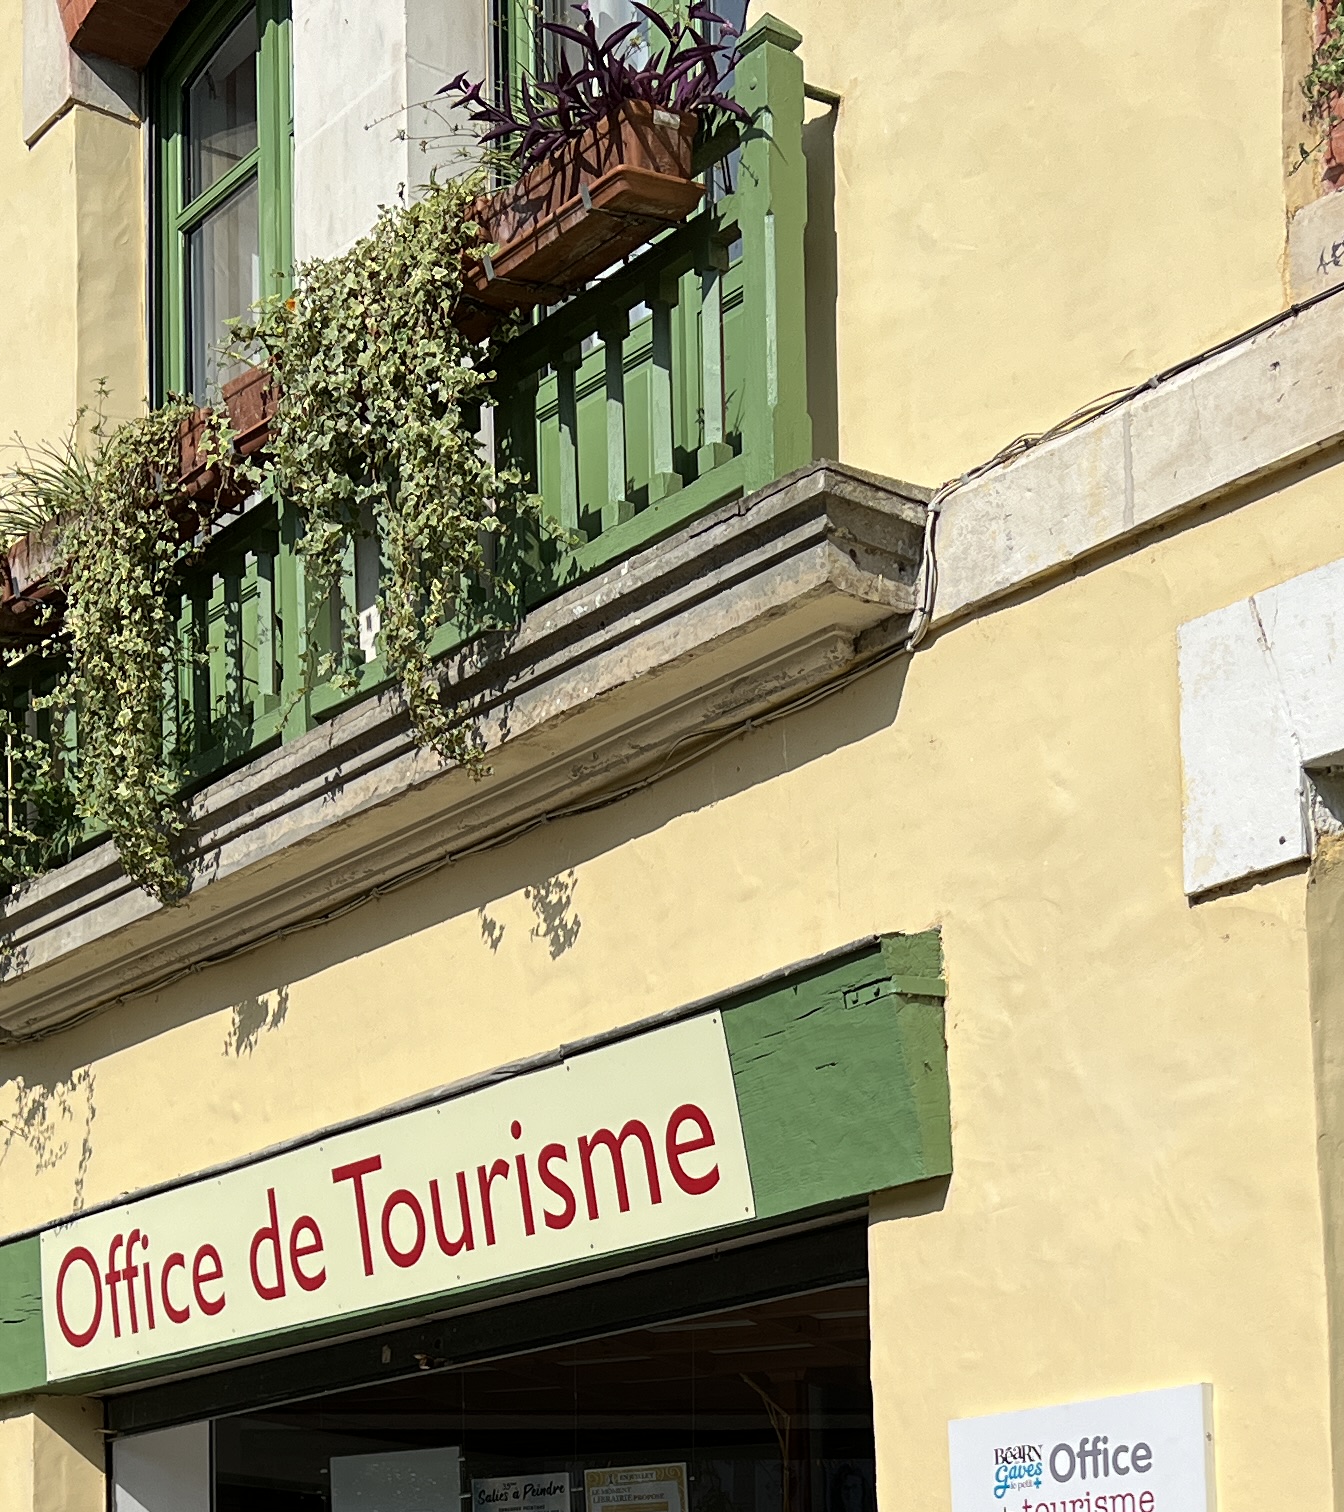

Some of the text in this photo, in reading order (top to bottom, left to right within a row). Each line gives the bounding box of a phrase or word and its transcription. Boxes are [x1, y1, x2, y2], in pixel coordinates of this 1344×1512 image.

[54, 1100, 723, 1348] Office de Tourisme
[1049, 1435, 1153, 1483] Office
[478, 1489, 509, 1505] Salies
[523, 1481, 565, 1501] Peindre
[593, 1494, 633, 1504] LIBRAIRIE
